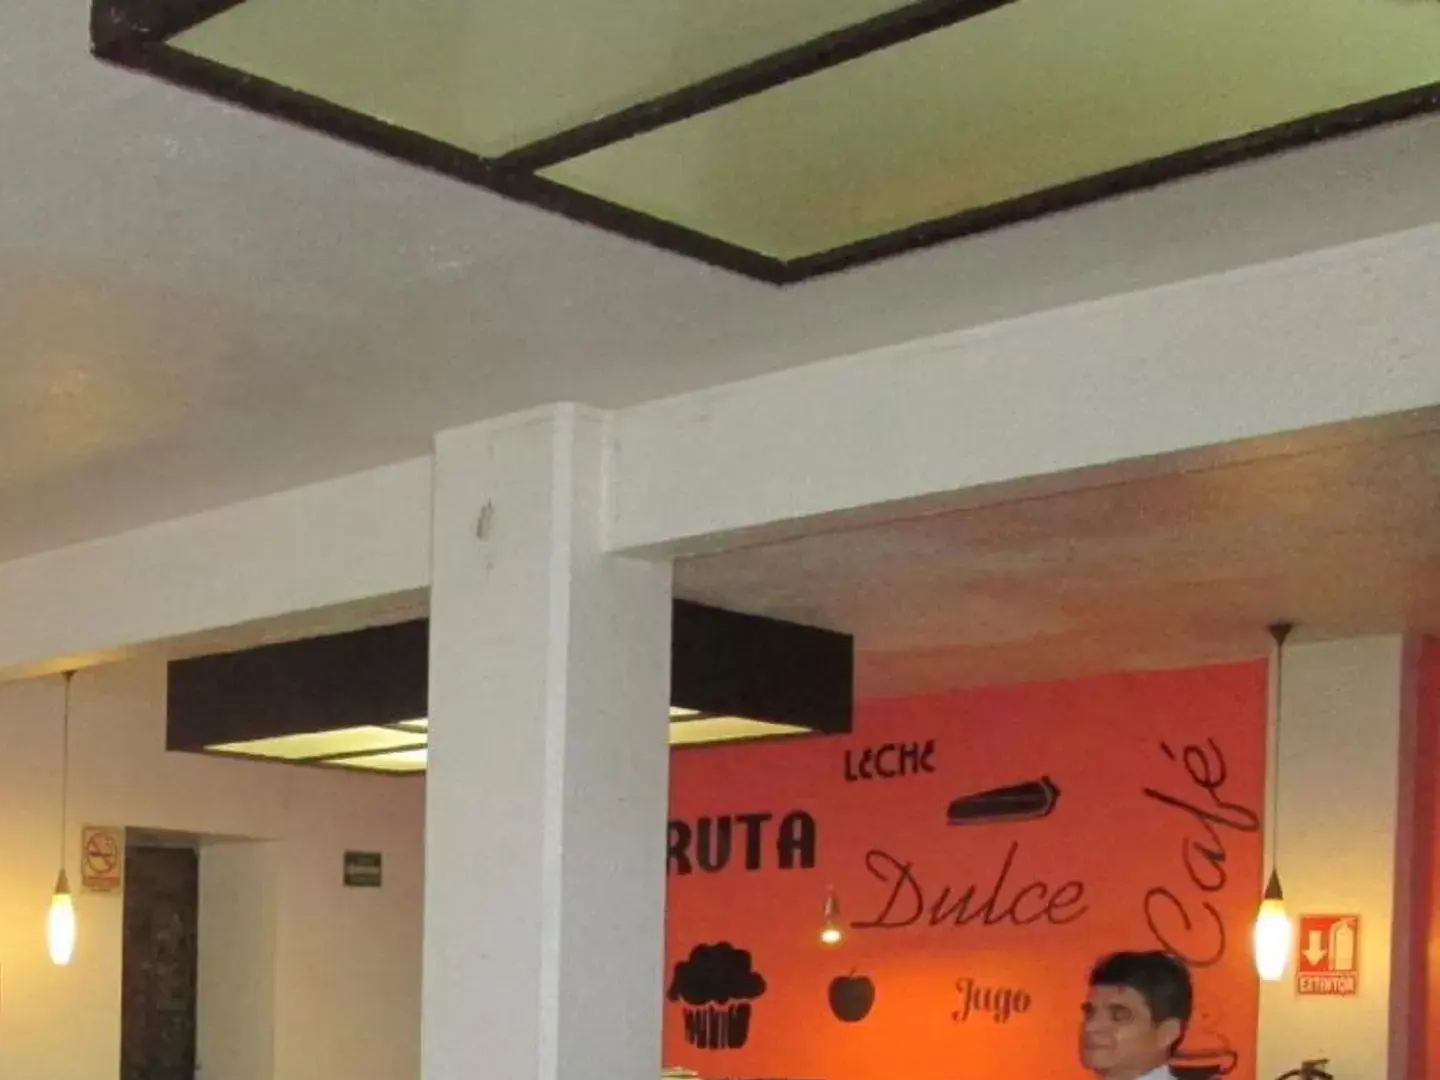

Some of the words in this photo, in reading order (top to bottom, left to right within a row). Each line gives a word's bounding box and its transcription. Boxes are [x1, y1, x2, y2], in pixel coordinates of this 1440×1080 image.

[850, 840, 1088, 928] Dulce
[1143, 737, 1259, 967] Café
[951, 977, 1032, 1024] Jugo
